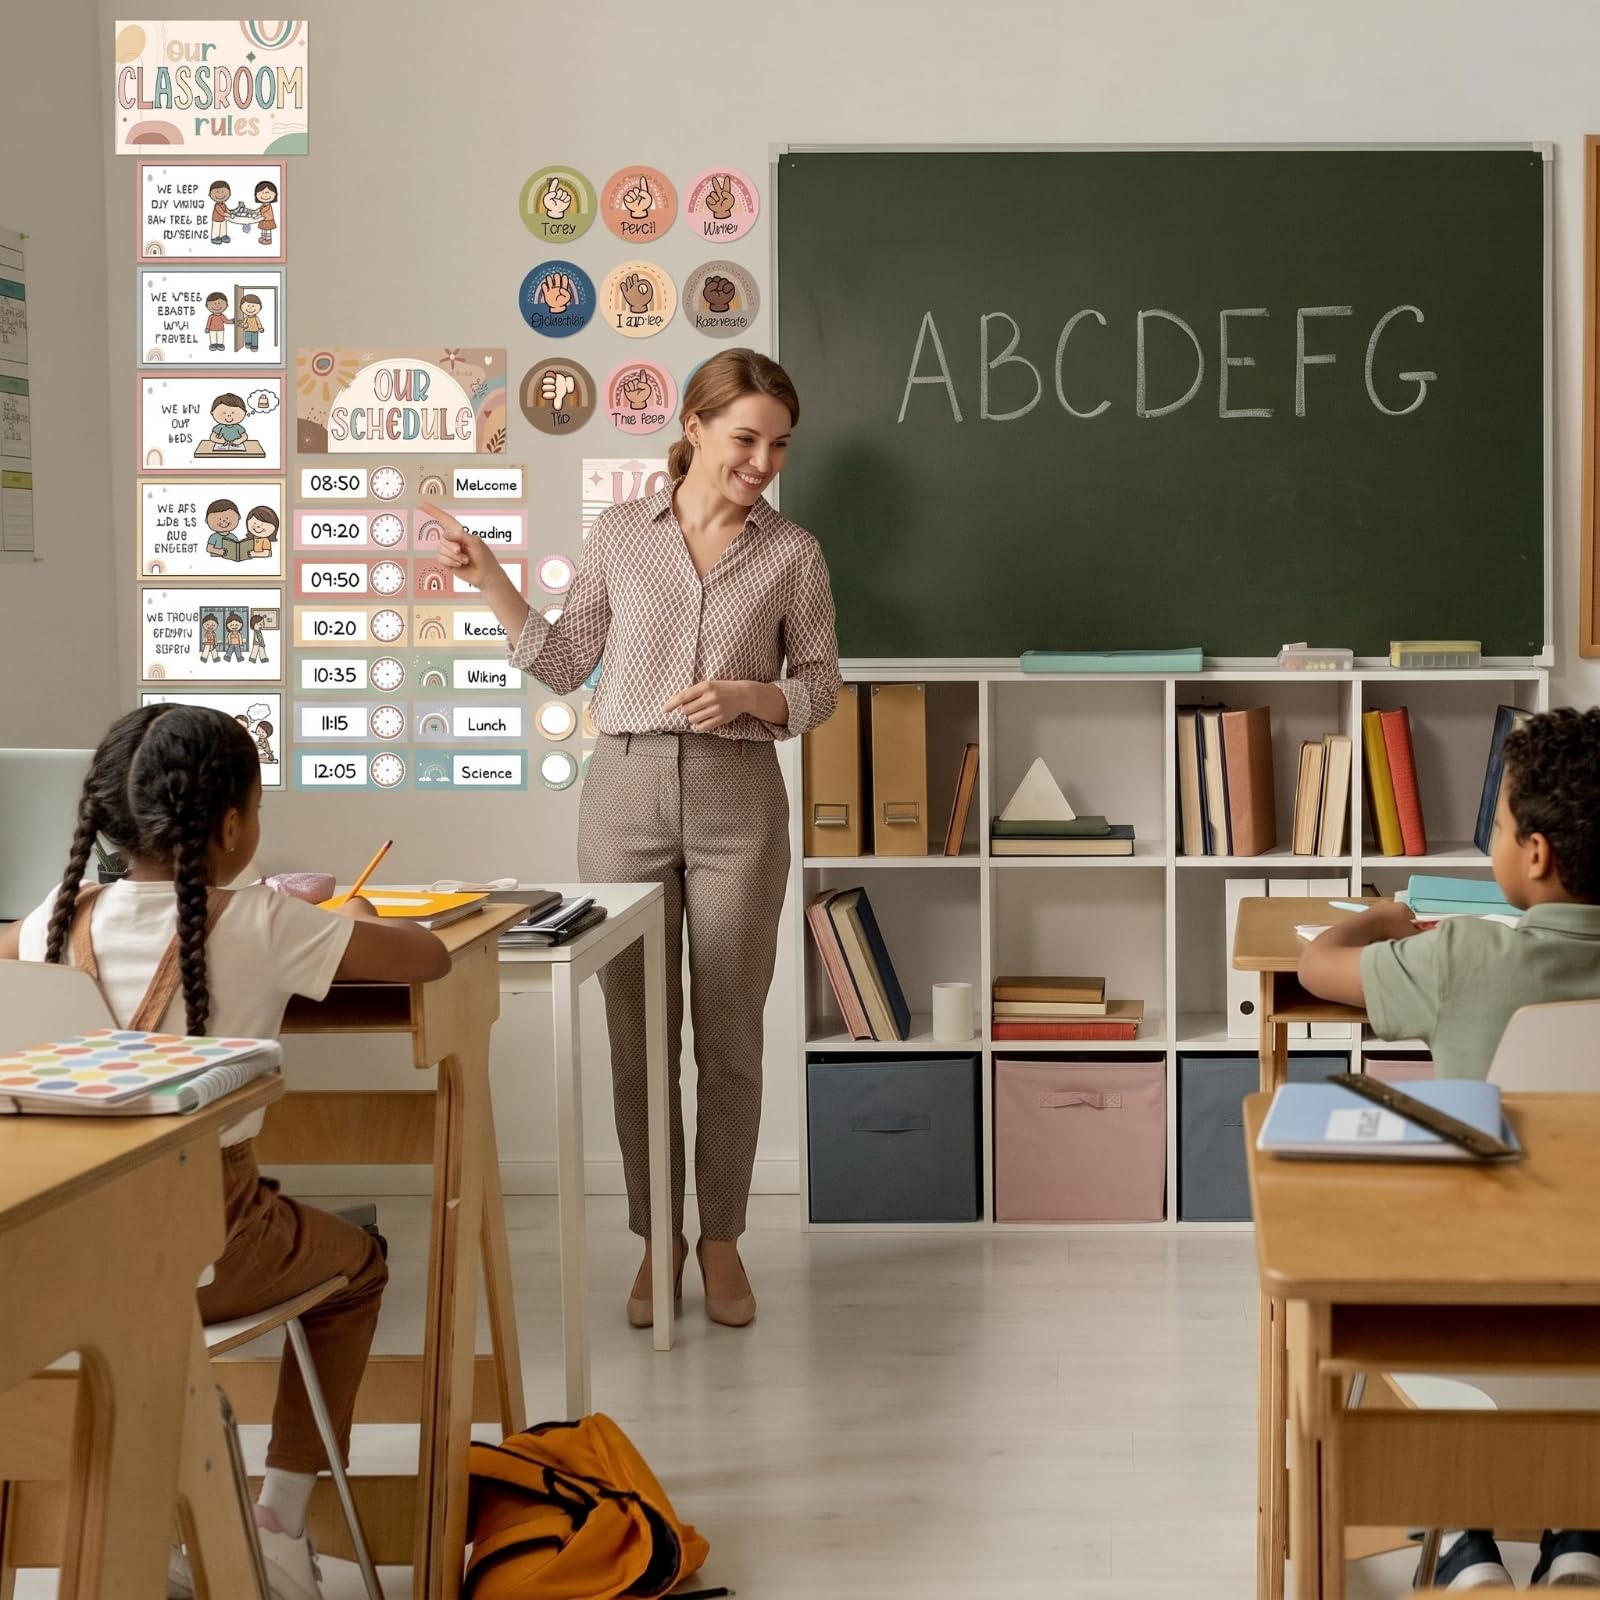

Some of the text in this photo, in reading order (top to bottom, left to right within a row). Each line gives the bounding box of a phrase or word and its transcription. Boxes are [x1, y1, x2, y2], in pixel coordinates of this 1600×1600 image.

[166, 39, 216, 62] our
[117, 65, 303, 110] CLASSROOM
[194, 114, 260, 136] rules
[157, 184, 172, 194] WE
[151, 292, 167, 302] WE
[898, 304, 1437, 423] ABCDEFG
[374, 369, 430, 401] OUR
[161, 404, 178, 414] WE
[331, 407, 472, 441] SCHEDULE
[311, 475, 360, 491] 08:50
[157, 503, 174, 513] WE
[311, 523, 360, 539] 09:20
[311, 571, 360, 588] 09:50
[314, 620, 357, 636] 10:20
[314, 667, 357, 683] 10:35
[322, 715, 348, 731] 11:15
[468, 717, 506, 731] Lunch
[314, 763, 357, 779] 12:05
[461, 766, 513, 779] Science
